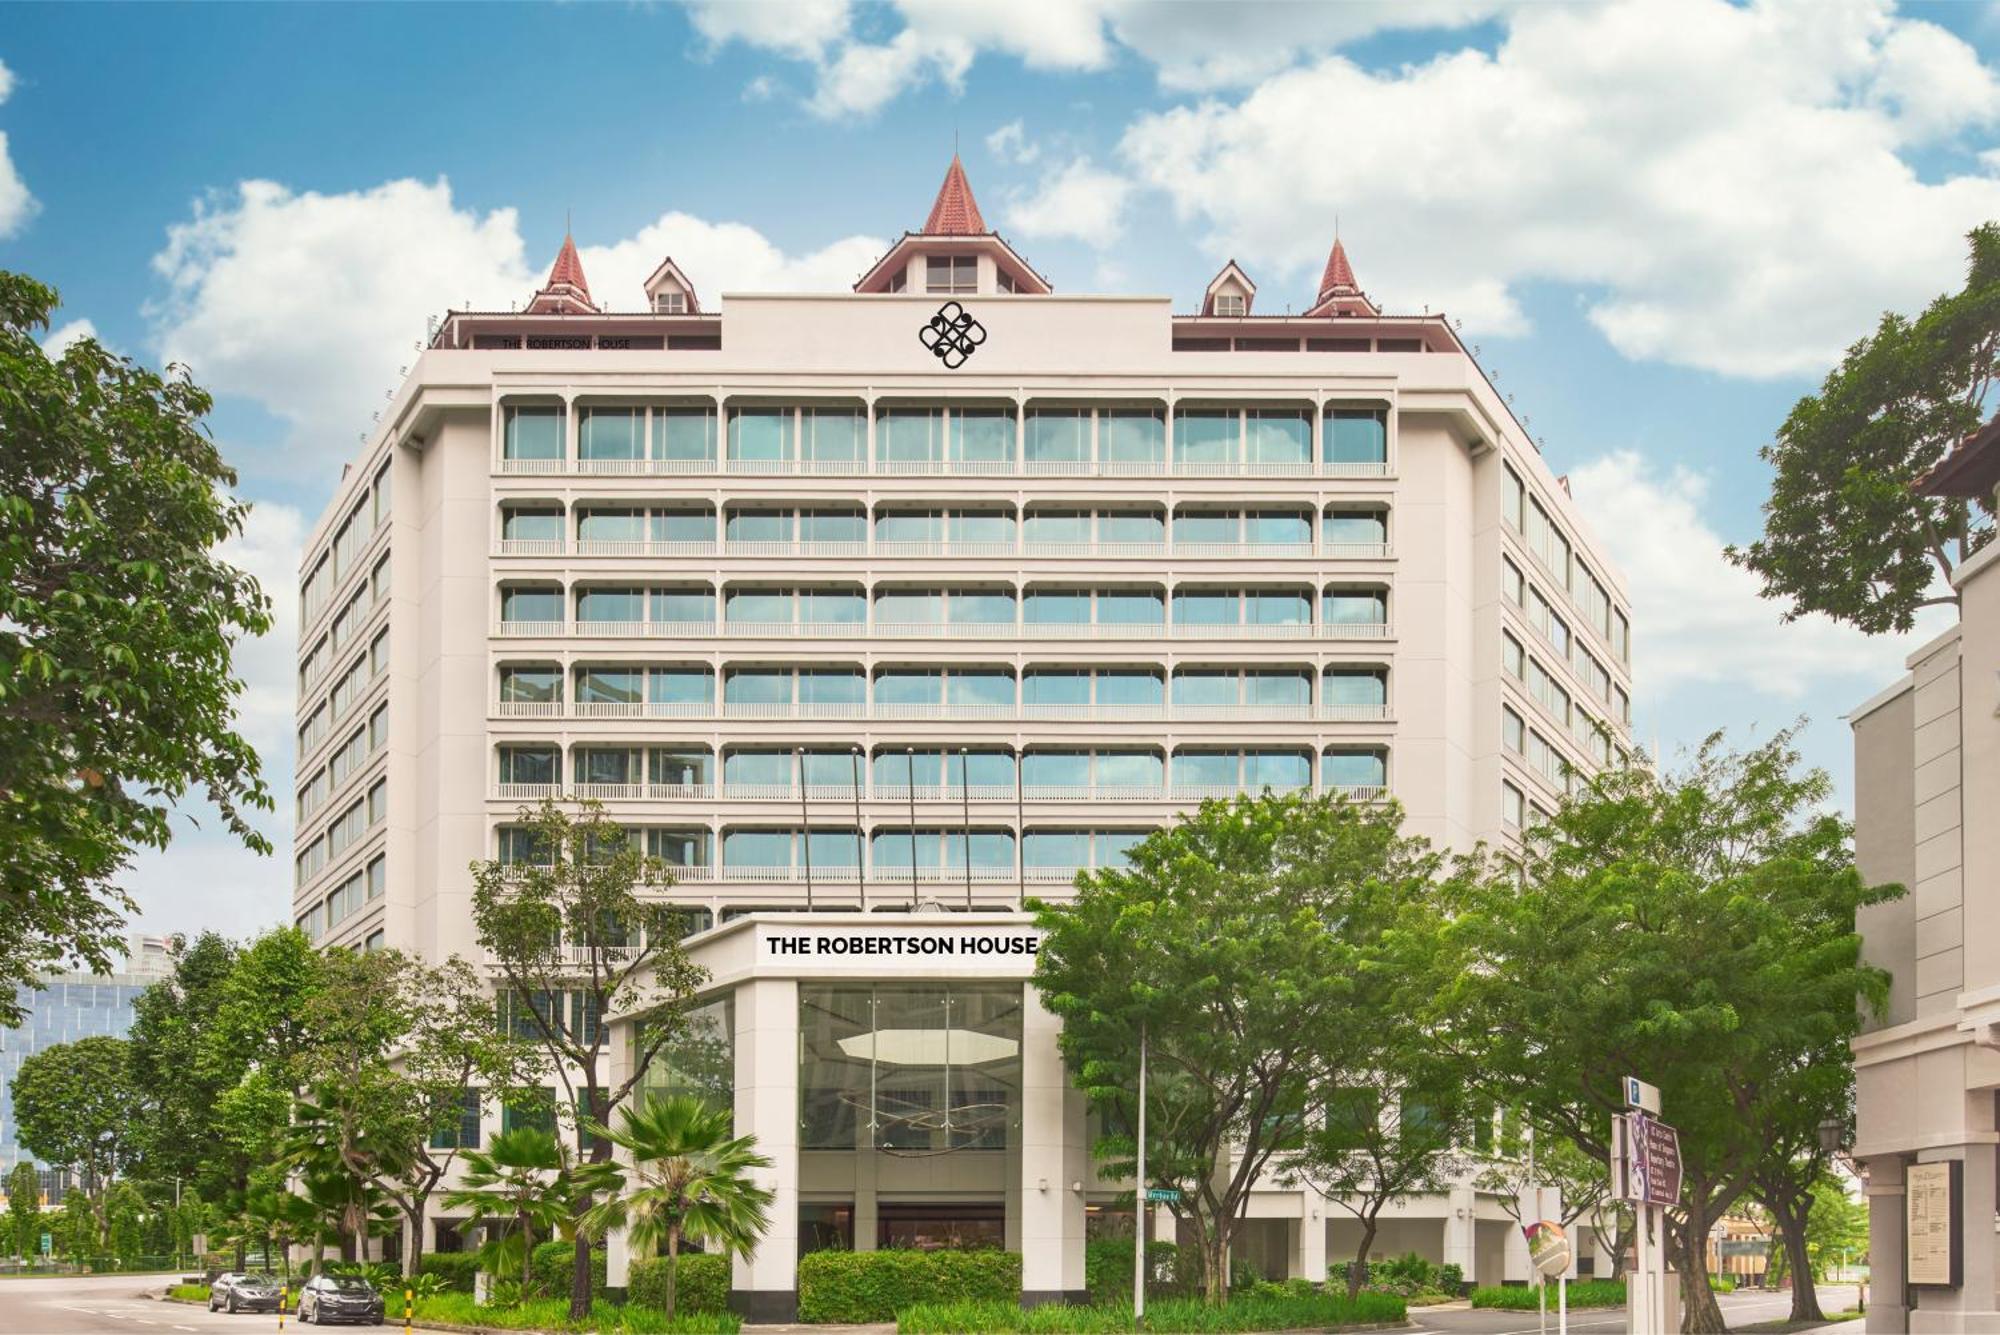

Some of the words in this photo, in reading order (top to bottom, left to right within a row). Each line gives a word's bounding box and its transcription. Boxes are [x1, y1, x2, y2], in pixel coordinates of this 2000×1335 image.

[502, 339, 522, 350] THE
[526, 339, 592, 350] ROBERTSON
[594, 339, 630, 350] HOUSE
[766, 937, 811, 954] THE
[817, 937, 955, 954] ROBERTSON
[961, 937, 1038, 954] HOUSE
